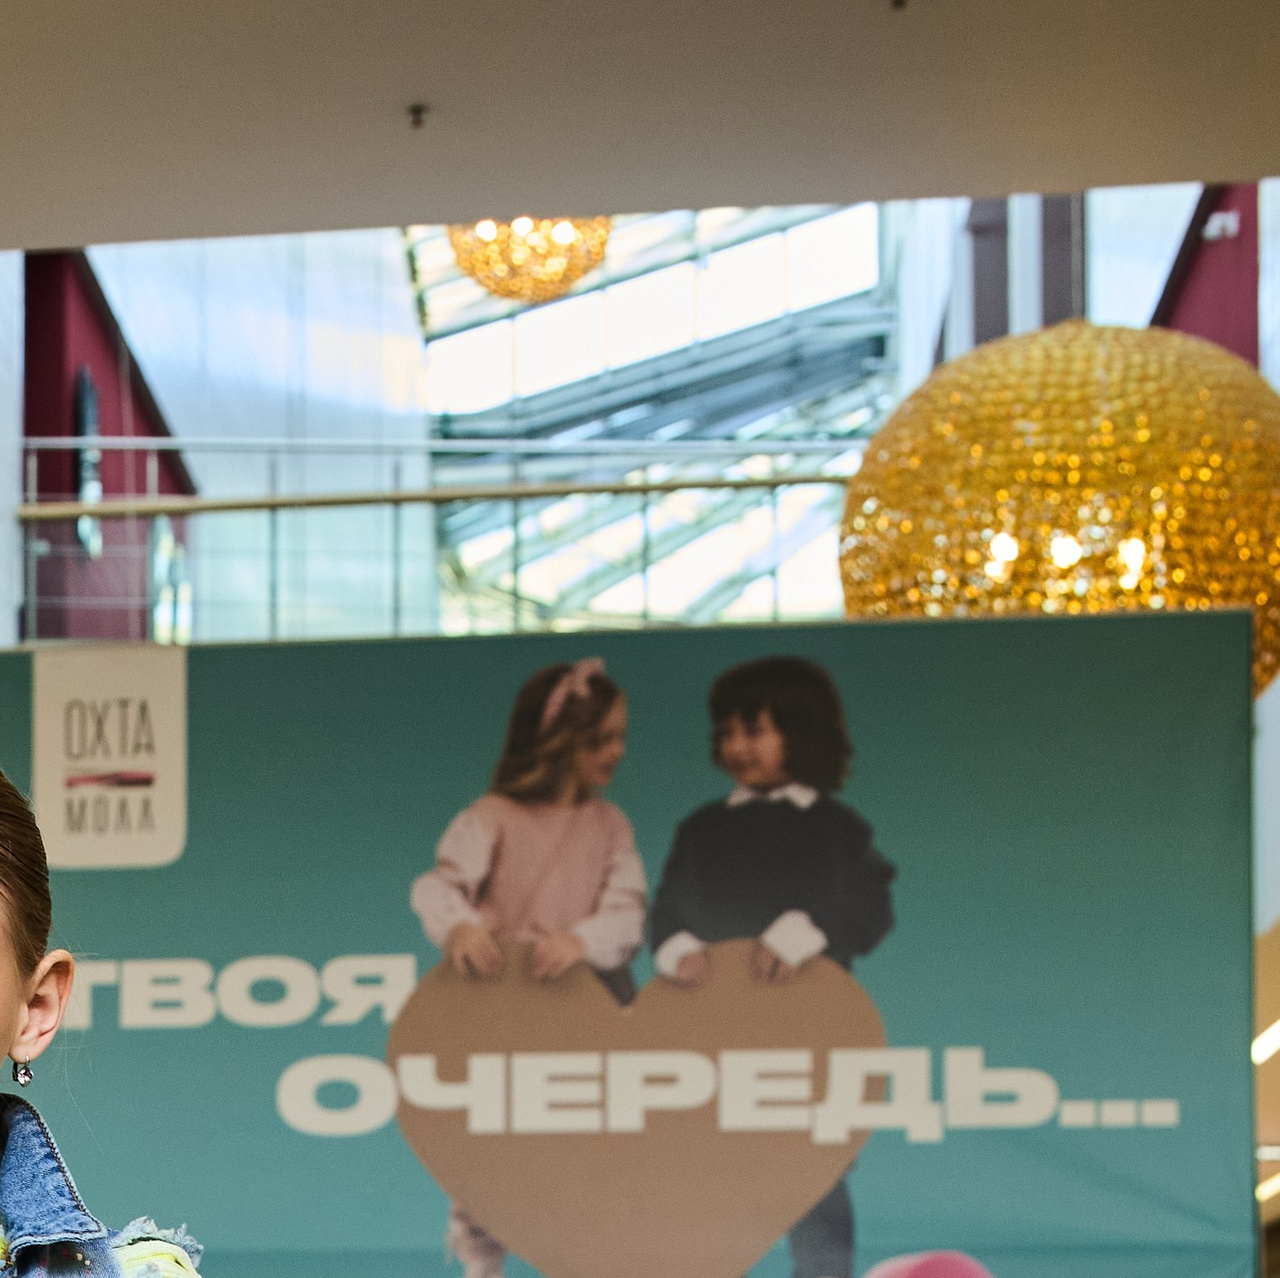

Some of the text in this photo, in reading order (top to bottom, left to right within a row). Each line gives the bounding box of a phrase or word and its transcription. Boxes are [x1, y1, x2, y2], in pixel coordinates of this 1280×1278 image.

[64, 697, 155, 759] ОХТА
[63, 953, 417, 1031] ТВОЯ
[275, 1045, 1180, 1143] ОЧЕРЕДЬ...
